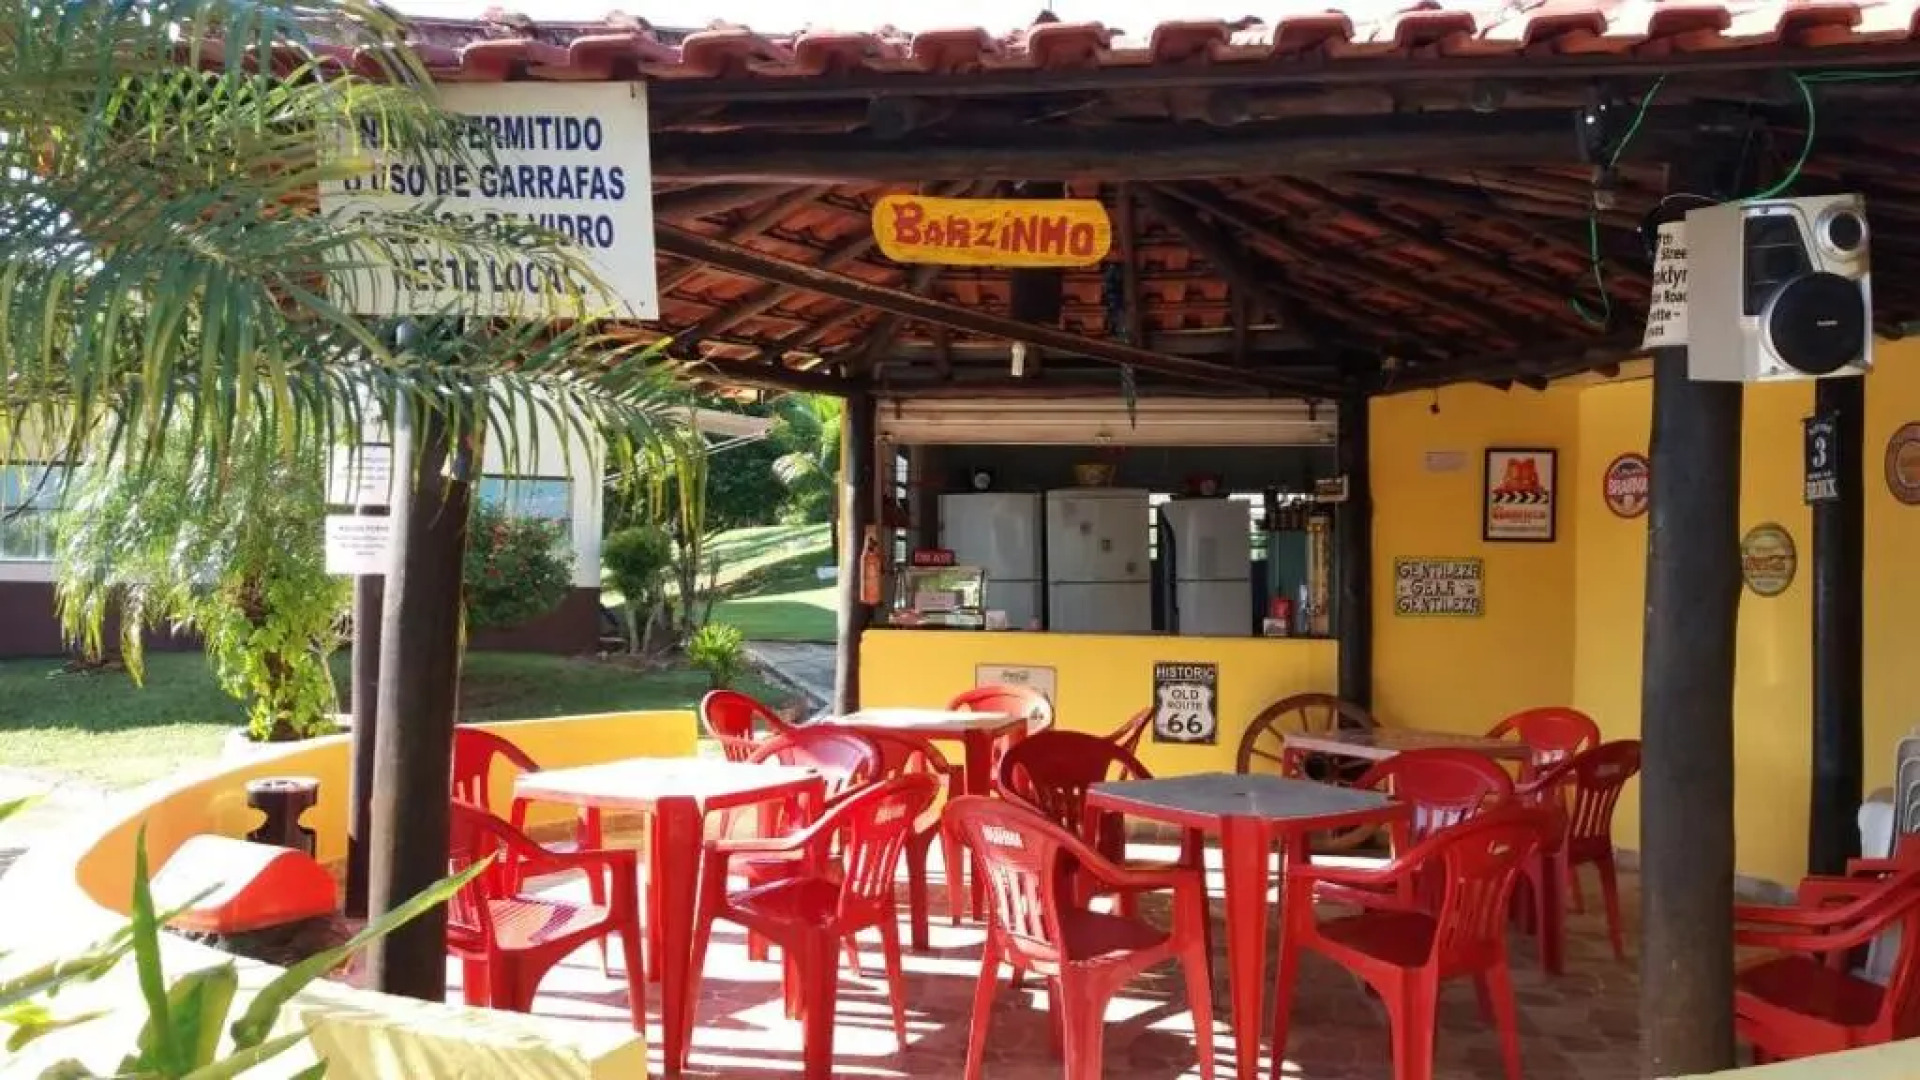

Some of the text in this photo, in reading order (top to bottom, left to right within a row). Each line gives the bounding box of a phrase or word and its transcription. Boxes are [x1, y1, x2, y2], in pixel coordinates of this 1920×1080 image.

[436, 163, 470, 198] DE
[480, 164, 626, 200] GARRAFAS
[489, 256, 586, 294] LOCA.
[1812, 436, 1827, 468] 3
[1156, 666, 1215, 679] HISTORIC
[1172, 689, 1199, 700] OLD
[1167, 713, 1203, 734] 66
